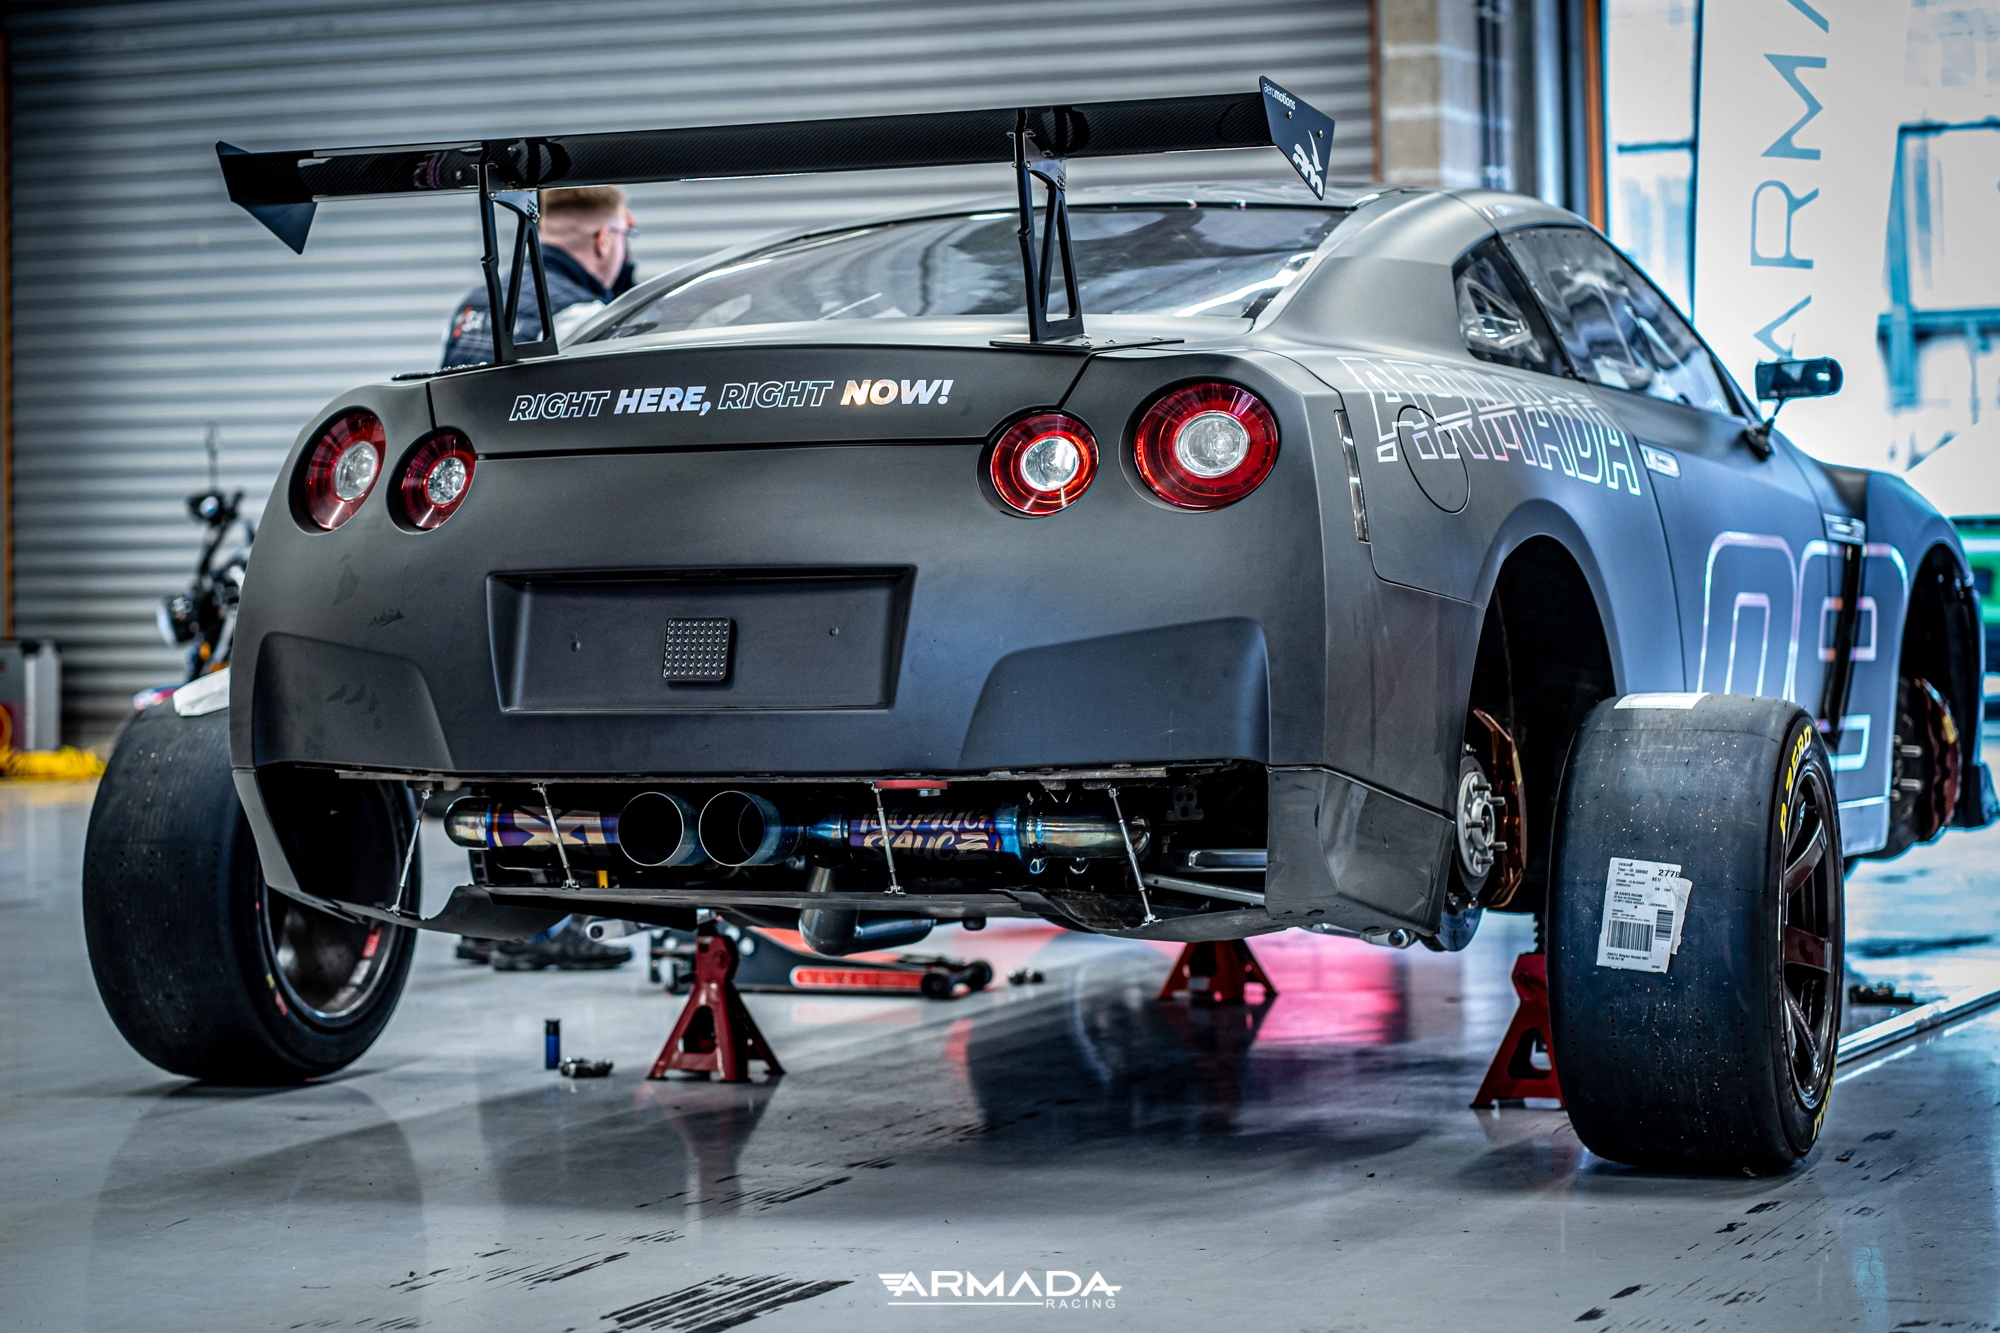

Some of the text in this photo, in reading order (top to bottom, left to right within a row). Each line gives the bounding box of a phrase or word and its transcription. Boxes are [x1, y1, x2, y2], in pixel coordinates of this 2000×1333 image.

[1263, 82, 1296, 111] aeromotions
[509, 379, 954, 421] RIGHT HERE, RIGHT NOW!
[1336, 356, 1642, 496] ARMADA
[1785, 725, 1812, 806] ZERO
